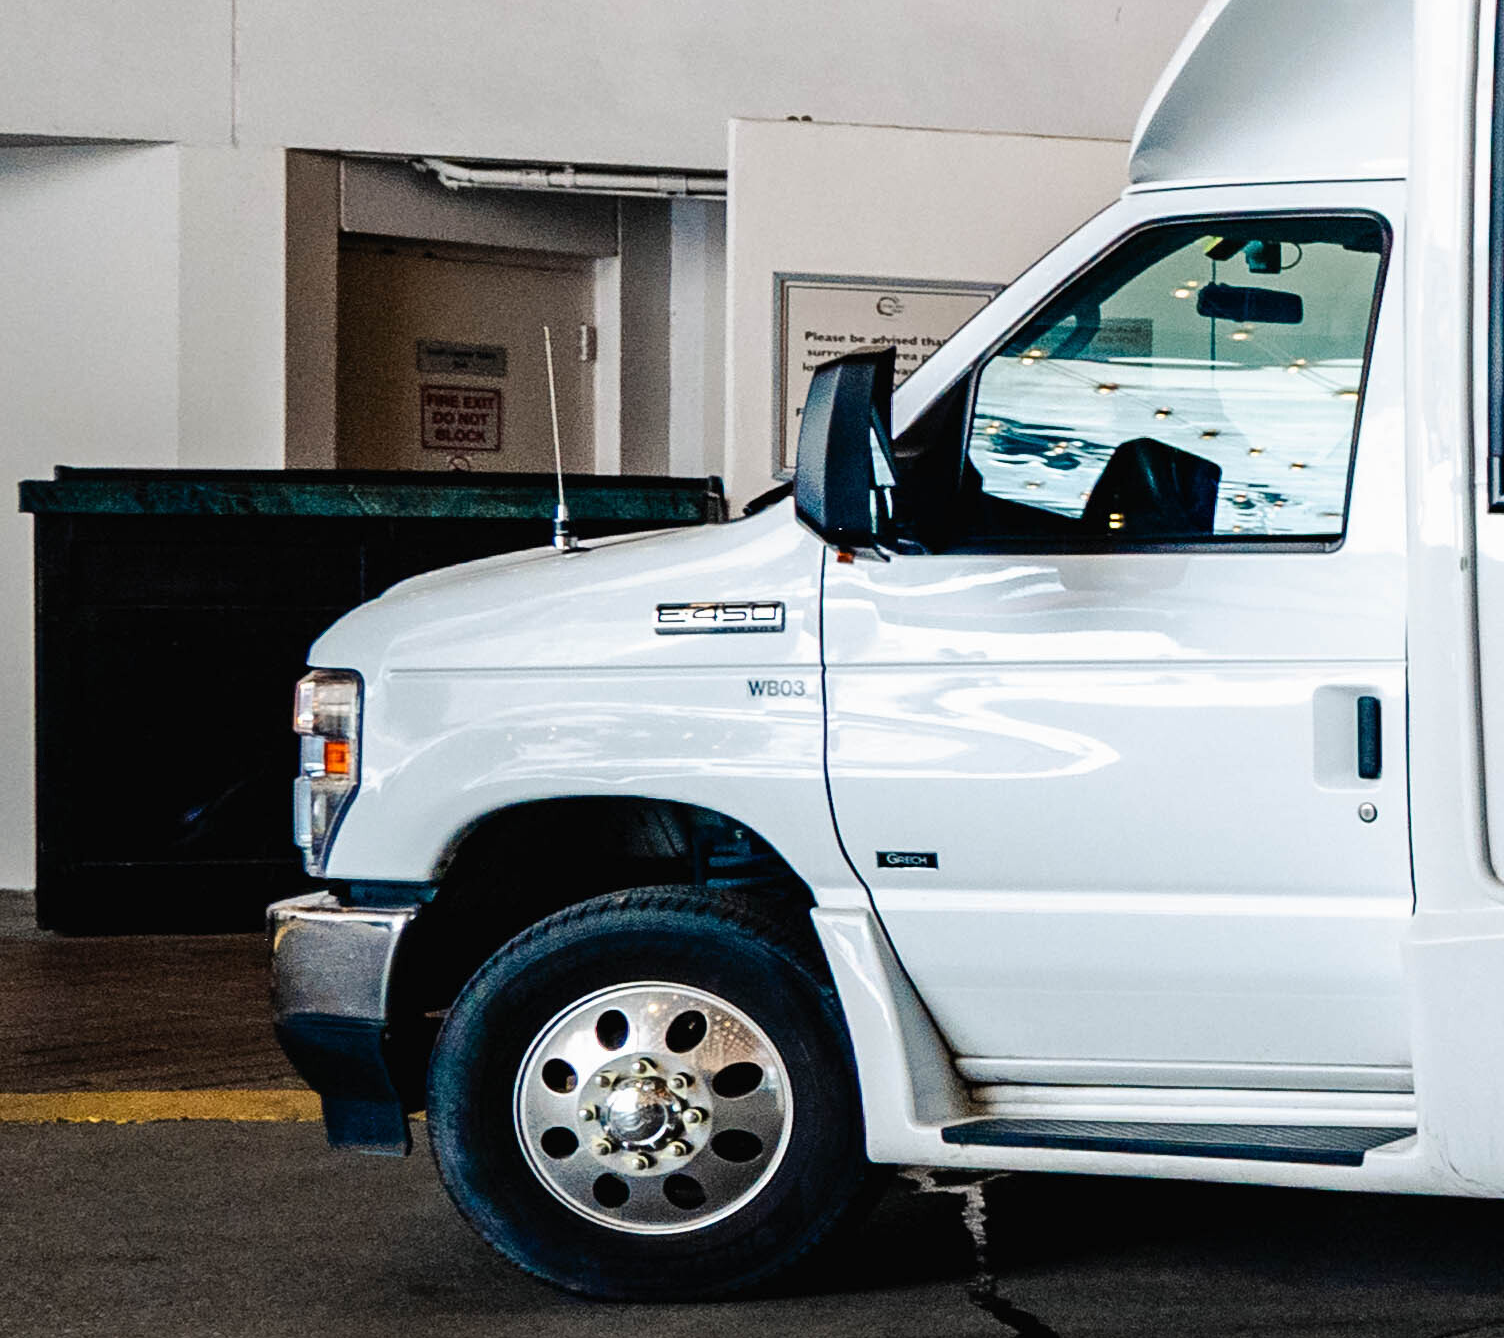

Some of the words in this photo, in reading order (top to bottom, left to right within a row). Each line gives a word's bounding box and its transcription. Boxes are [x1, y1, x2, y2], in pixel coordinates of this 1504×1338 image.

[804, 331, 845, 342] Please
[850, 333, 866, 343] be
[871, 335, 918, 346] advised
[426, 393, 459, 408] FIRE
[462, 396, 496, 410] EXIT
[431, 411, 455, 424] DO
[459, 413, 489, 426] NOT
[434, 428, 486, 443] BLOCK
[747, 680, 806, 697] WB03
